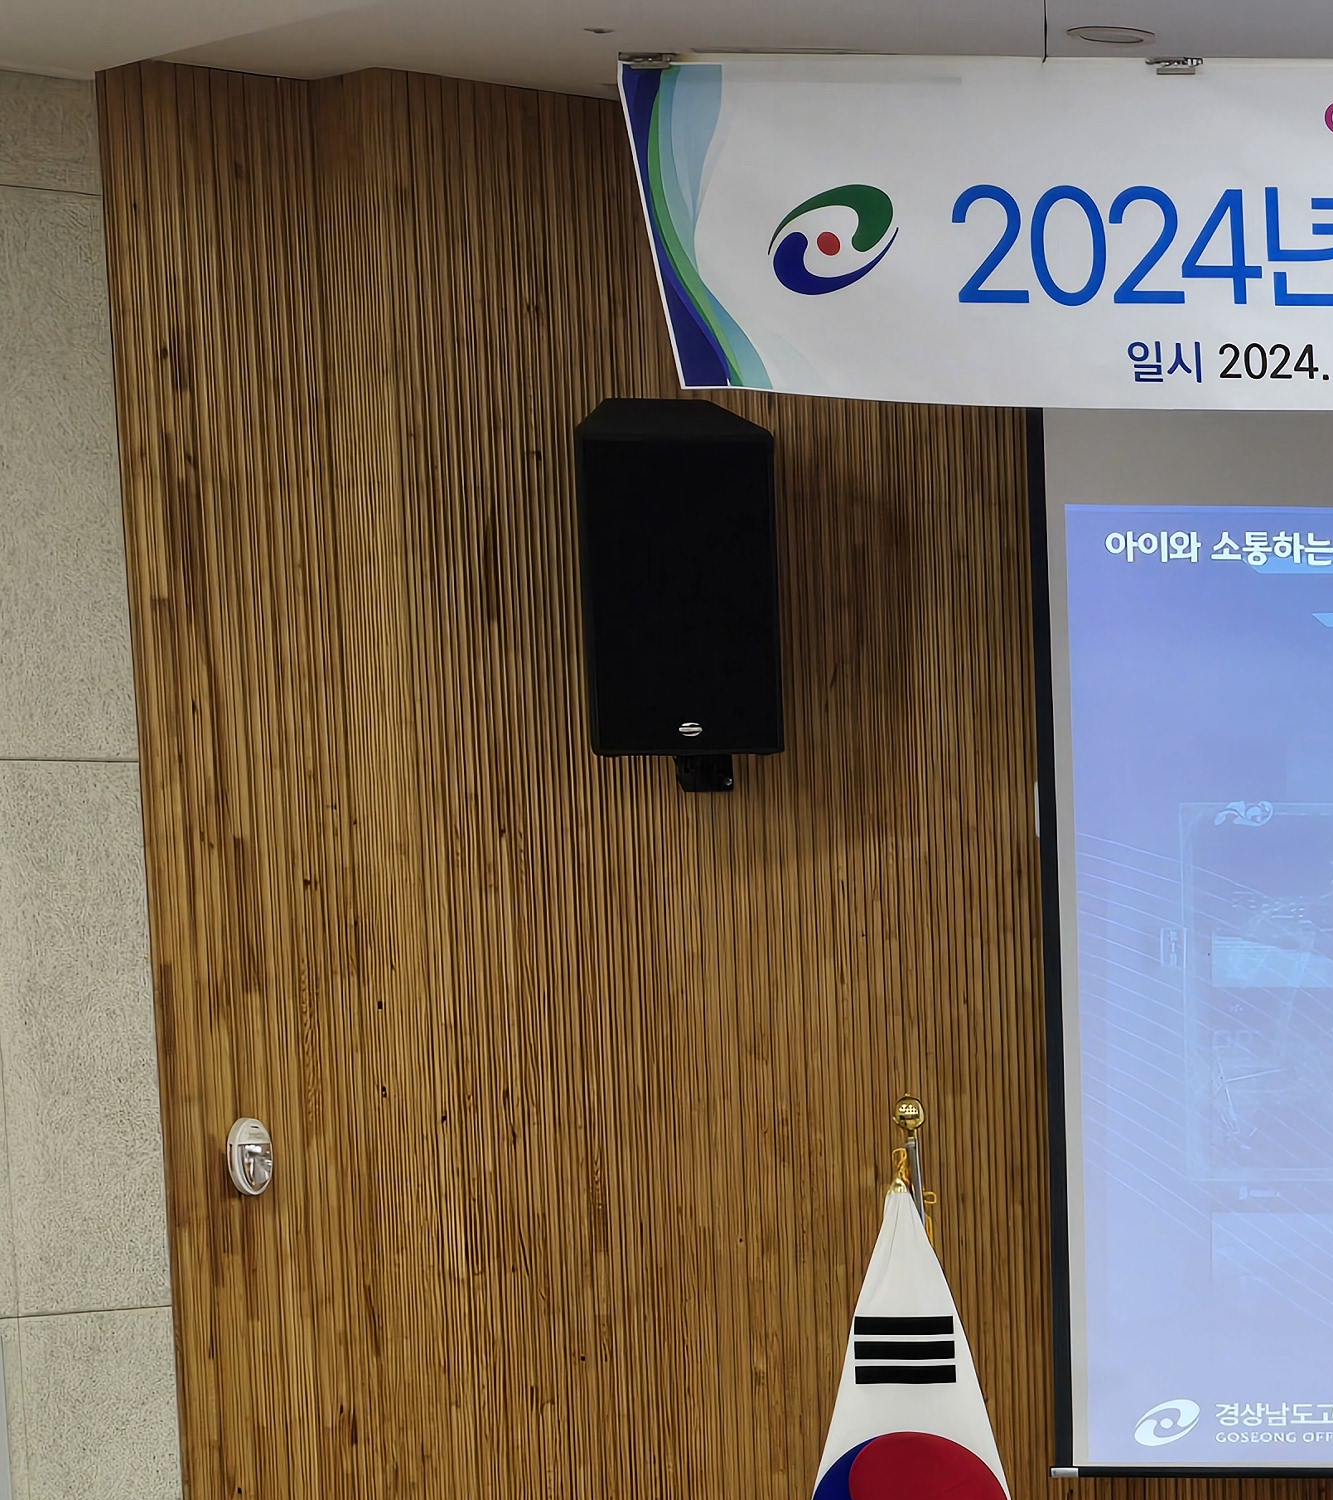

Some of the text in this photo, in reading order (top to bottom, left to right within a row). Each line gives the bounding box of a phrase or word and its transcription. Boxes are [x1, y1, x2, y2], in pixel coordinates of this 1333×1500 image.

[1127, 340, 1202, 384] 일시
[1218, 342, 1330, 381] 2024.
[1105, 530, 1202, 563] 아이와
[1211, 531, 1333, 566] 소통하는
[1214, 1431, 1297, 1443] GOSEONG
